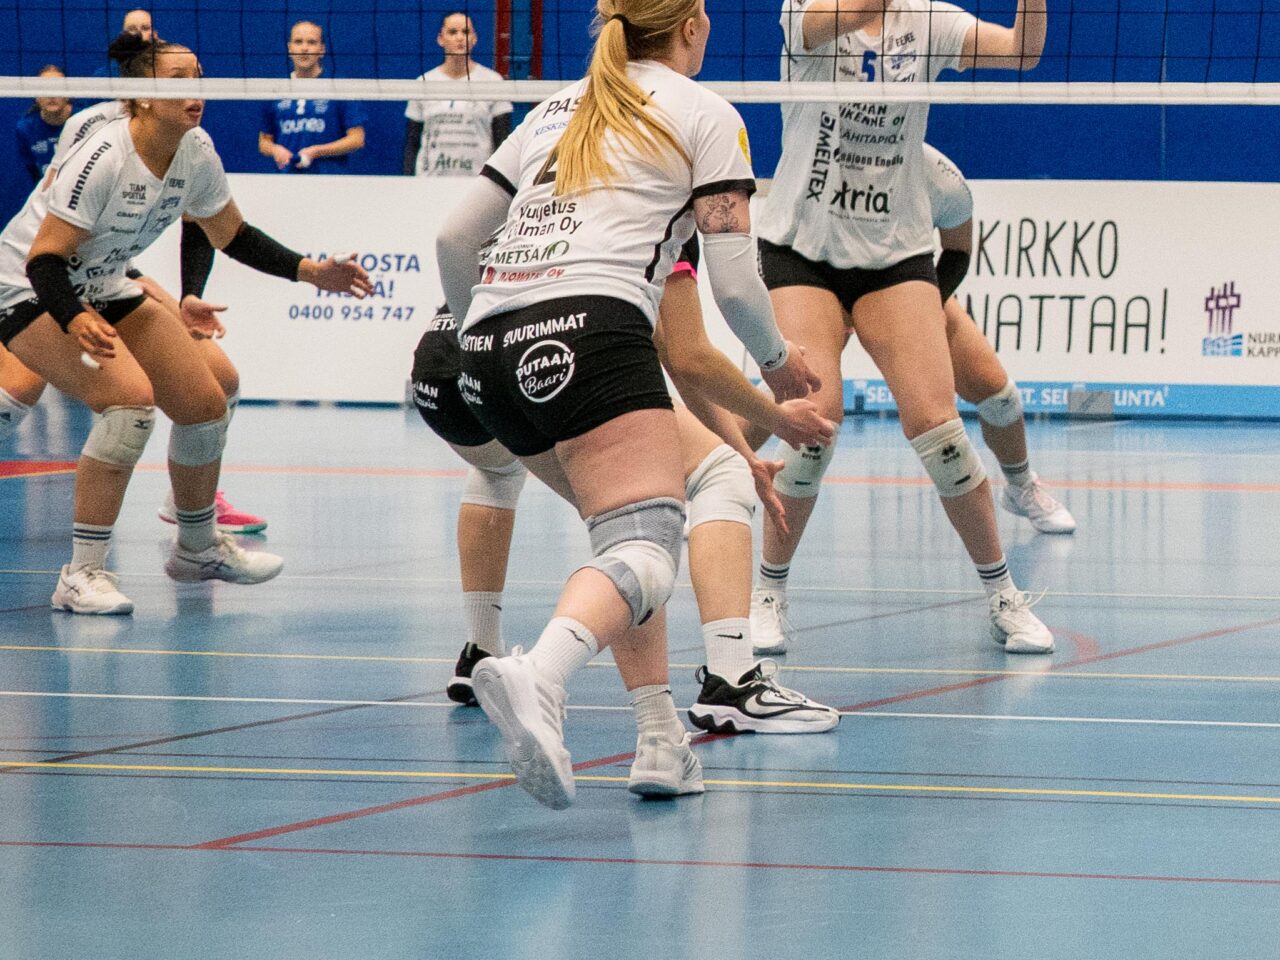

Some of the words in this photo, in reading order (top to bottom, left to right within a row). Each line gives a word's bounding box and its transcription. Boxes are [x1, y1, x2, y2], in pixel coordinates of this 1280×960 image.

[861, 50, 877, 82] 5
[806, 129, 832, 202] MELTEX
[560, 216, 583, 235] Oy
[977, 217, 1118, 279] KIRKKO
[289, 305, 333, 320] 0400
[341, 305, 374, 320] 954
[382, 305, 415, 320] 747
[503, 312, 587, 348] SUURIMMAT
[515, 352, 575, 382] PUTAAN
[524, 368, 566, 395] Baari
